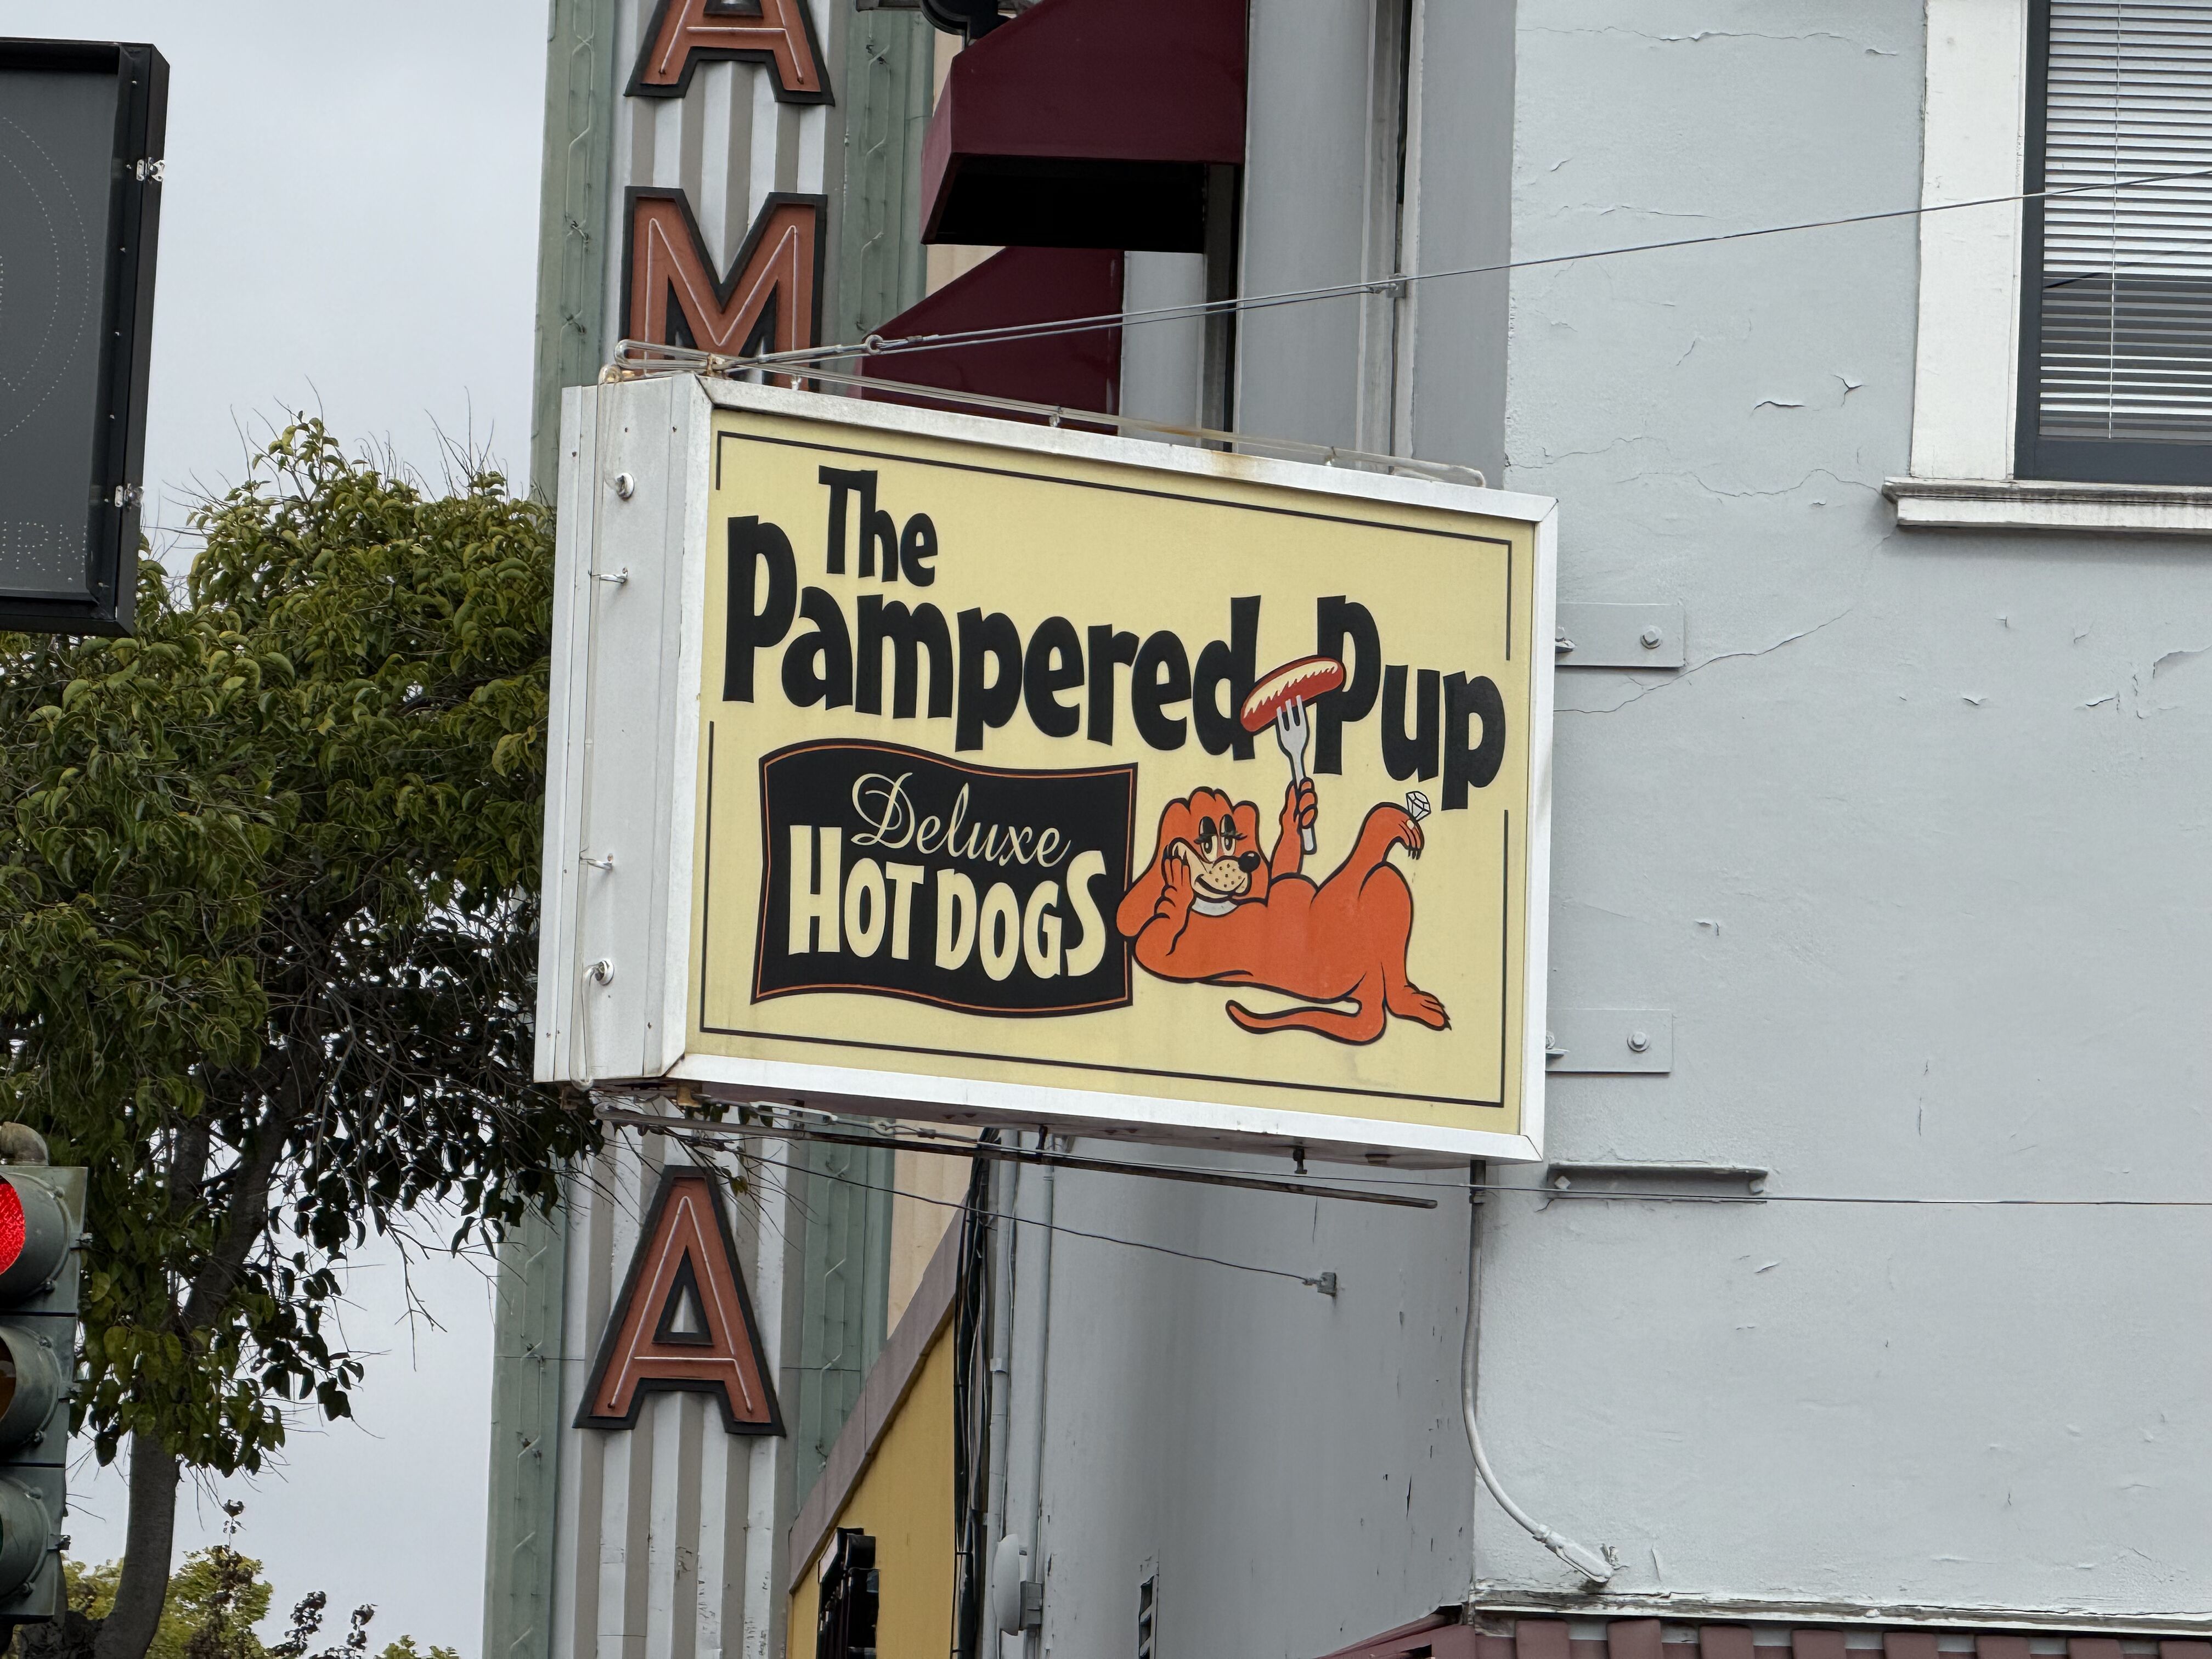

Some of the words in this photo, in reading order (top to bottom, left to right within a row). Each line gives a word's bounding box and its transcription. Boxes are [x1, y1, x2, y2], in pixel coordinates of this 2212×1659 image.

[819, 465, 938, 586] The
[723, 515, 1261, 761] Pampered
[1313, 595, 1505, 810] Pup
[851, 772, 1071, 867] Deluxe
[788, 825, 924, 960] HOT
[935, 850, 1107, 981] DOGS
